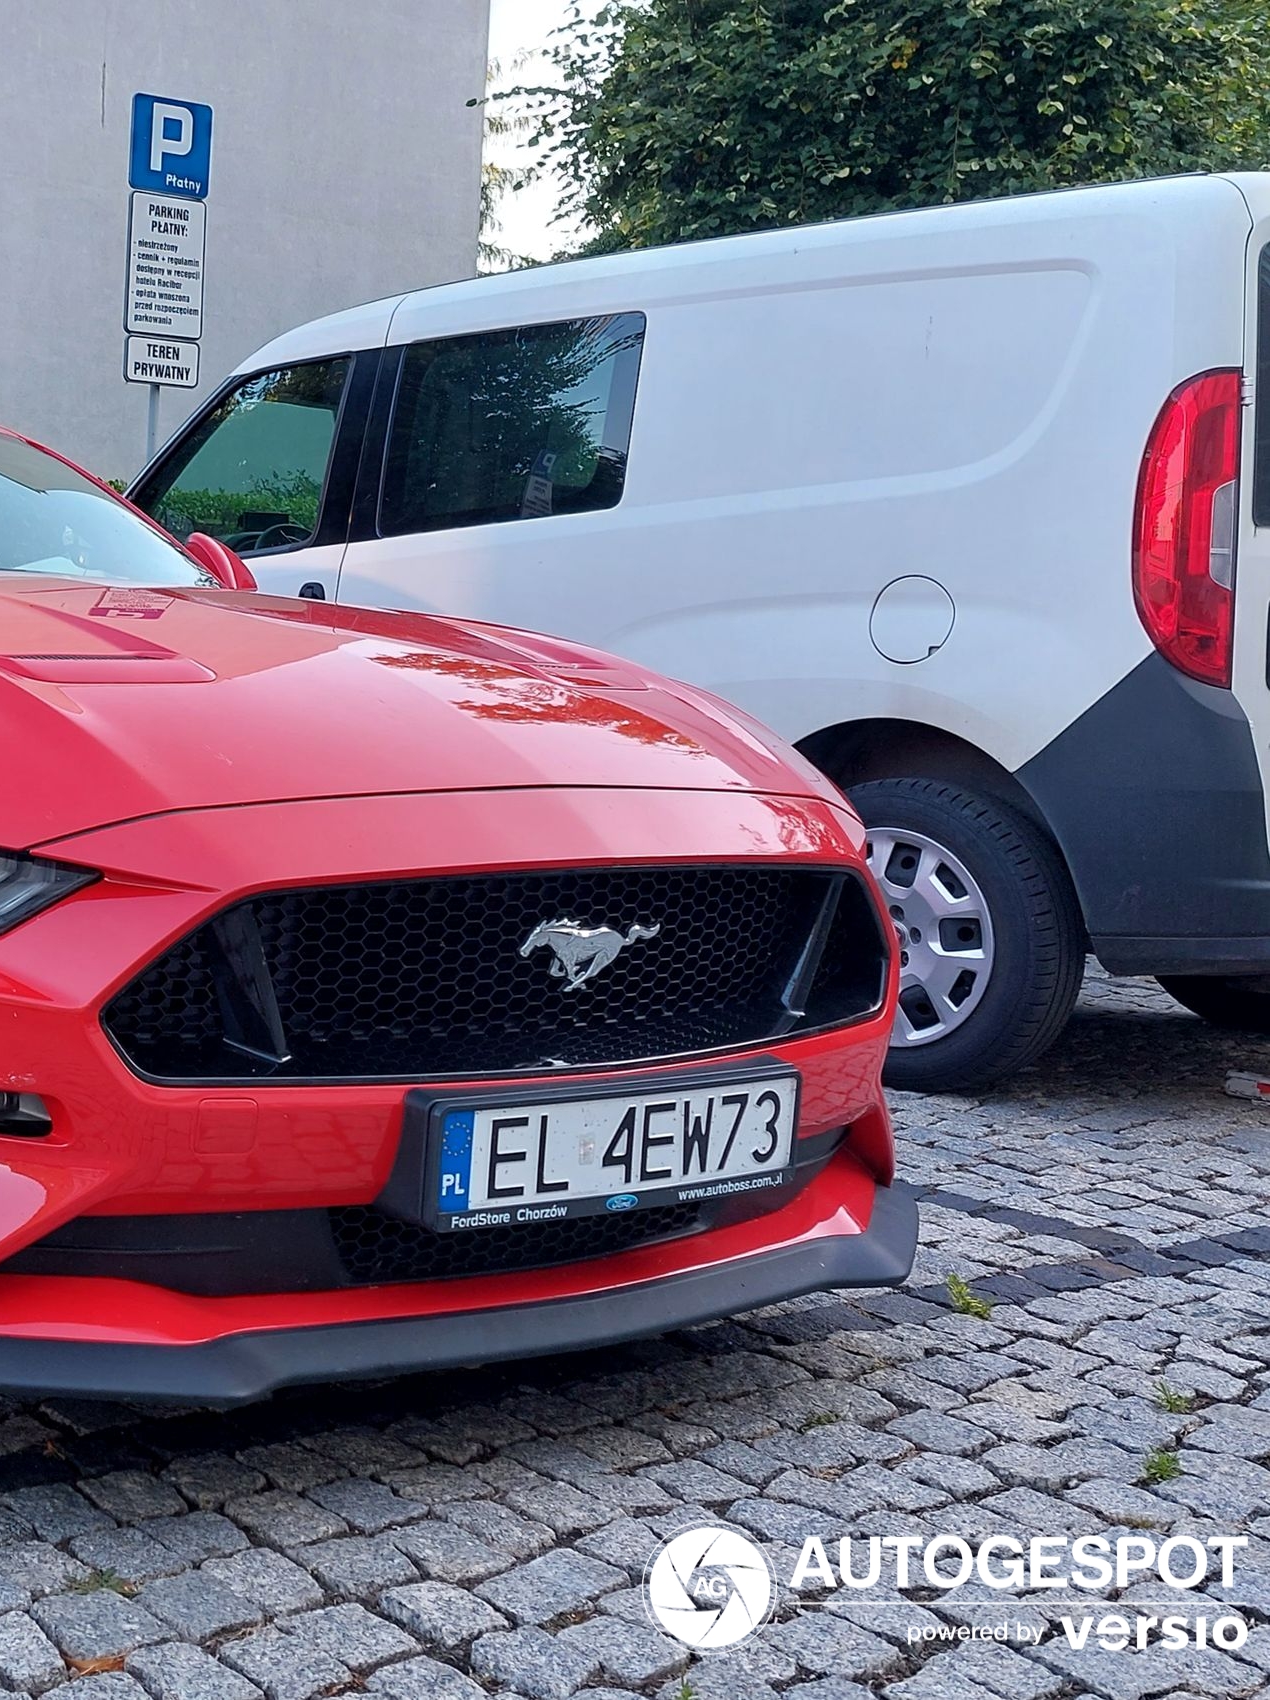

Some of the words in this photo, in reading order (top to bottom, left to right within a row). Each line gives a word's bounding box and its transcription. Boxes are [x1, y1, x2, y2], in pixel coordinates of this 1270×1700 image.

[150, 101, 193, 171] P
[165, 173, 201, 194] Płatny
[148, 203, 190, 222] PARKING
[151, 220, 188, 238] PŁATNY:
[137, 252, 160, 263] cennik
[166, 268, 173, 276] w
[134, 301, 153, 311] przed
[158, 291, 190, 303] wnoszona
[134, 313, 173, 326] parkowania
[146, 343, 180, 361] TEREN
[133, 361, 191, 381] PRYWATNY
[486, 1115, 569, 1200] EL
[601, 1089, 782, 1185] 4EW73
[441, 1173, 465, 1197] PL
[450, 1212, 511, 1229] FordStore
[516, 1204, 568, 1222] Chorzów
